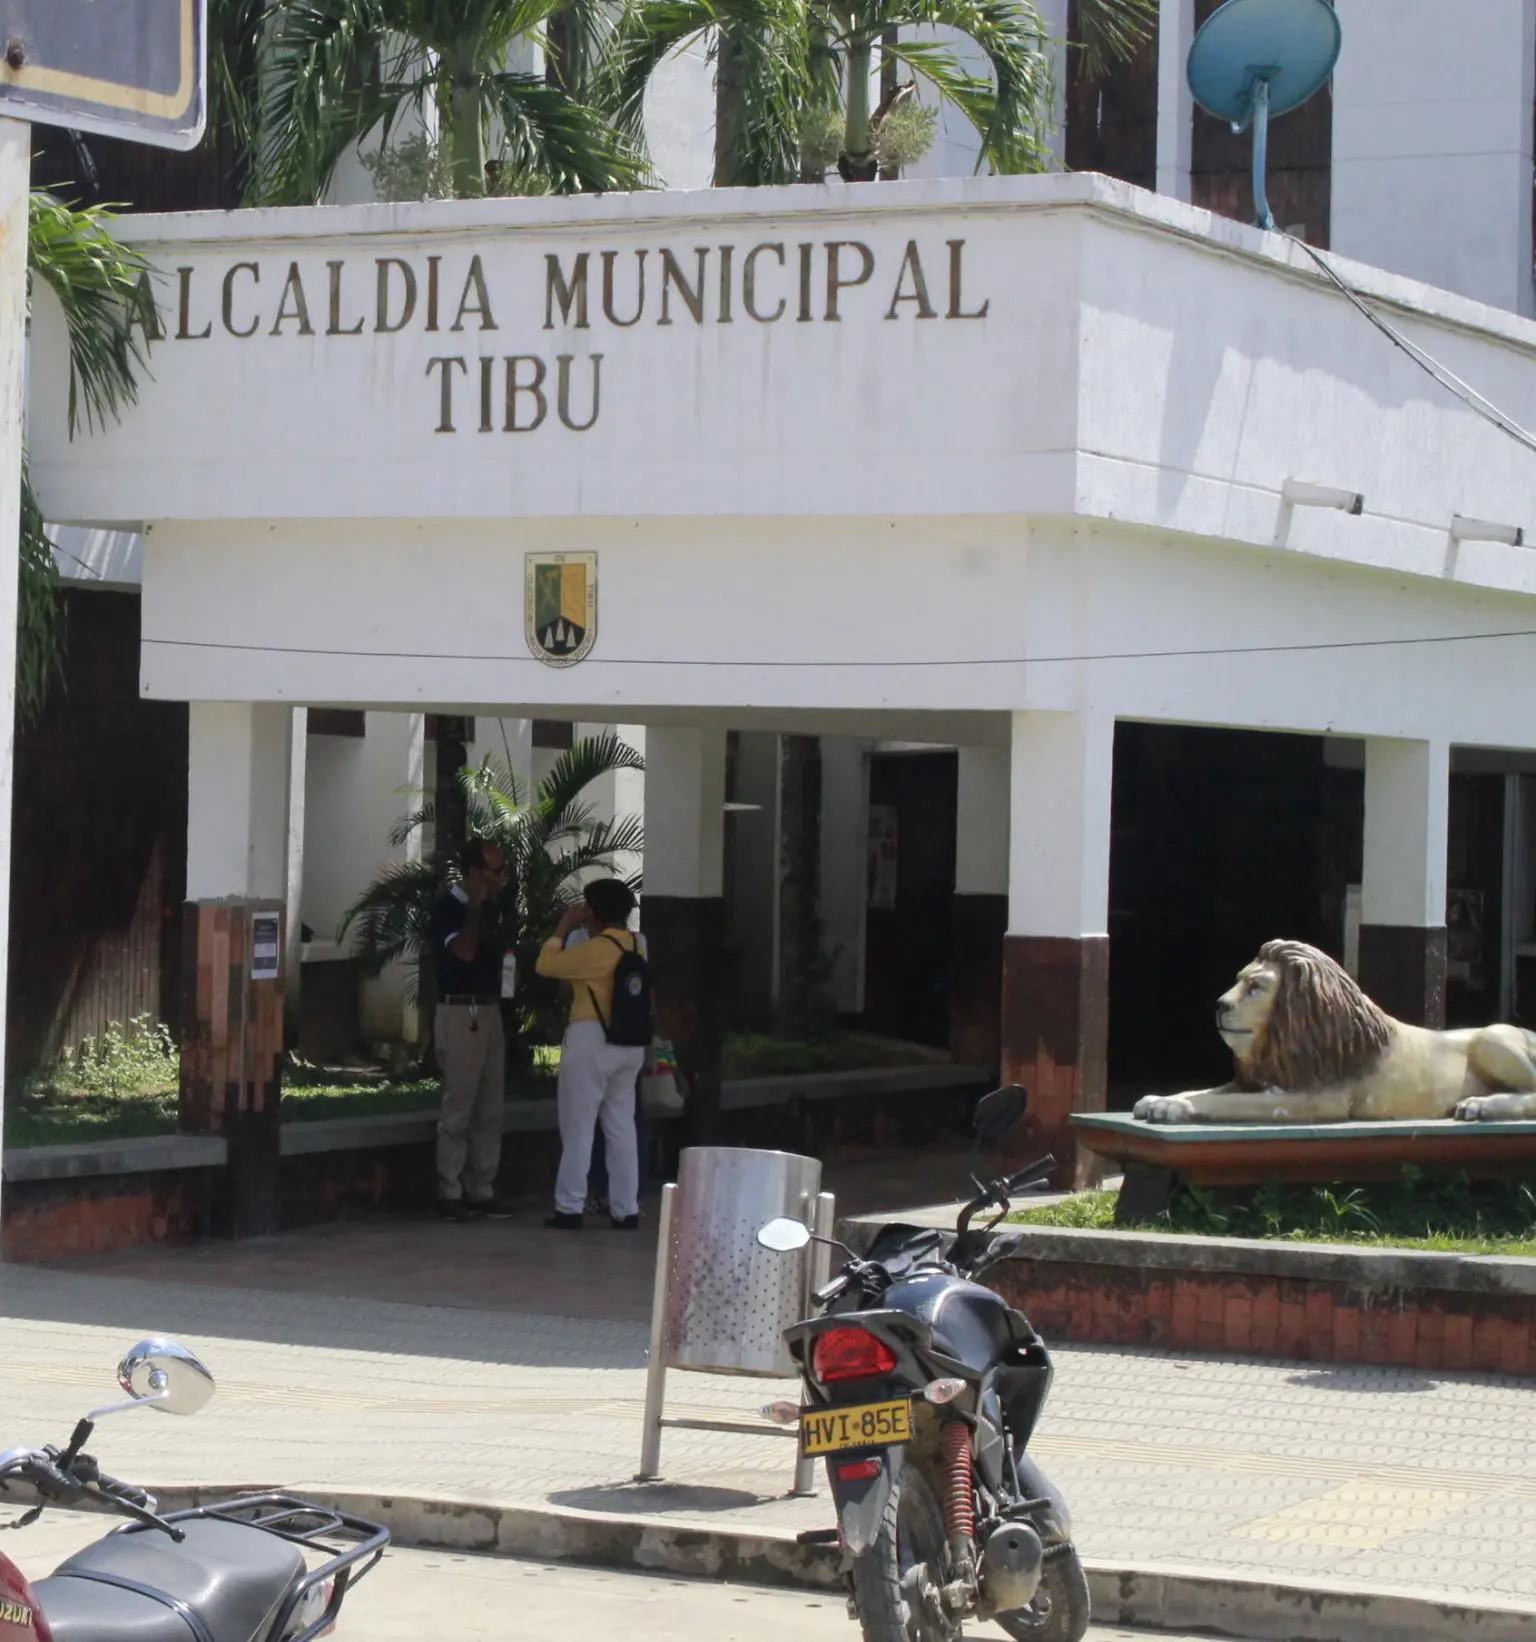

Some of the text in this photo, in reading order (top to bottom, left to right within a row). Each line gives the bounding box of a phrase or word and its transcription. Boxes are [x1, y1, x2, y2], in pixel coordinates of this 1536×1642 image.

[125, 239, 990, 341] ALCALDIA MUNICIPAL
[425, 353, 604, 433] TIBU
